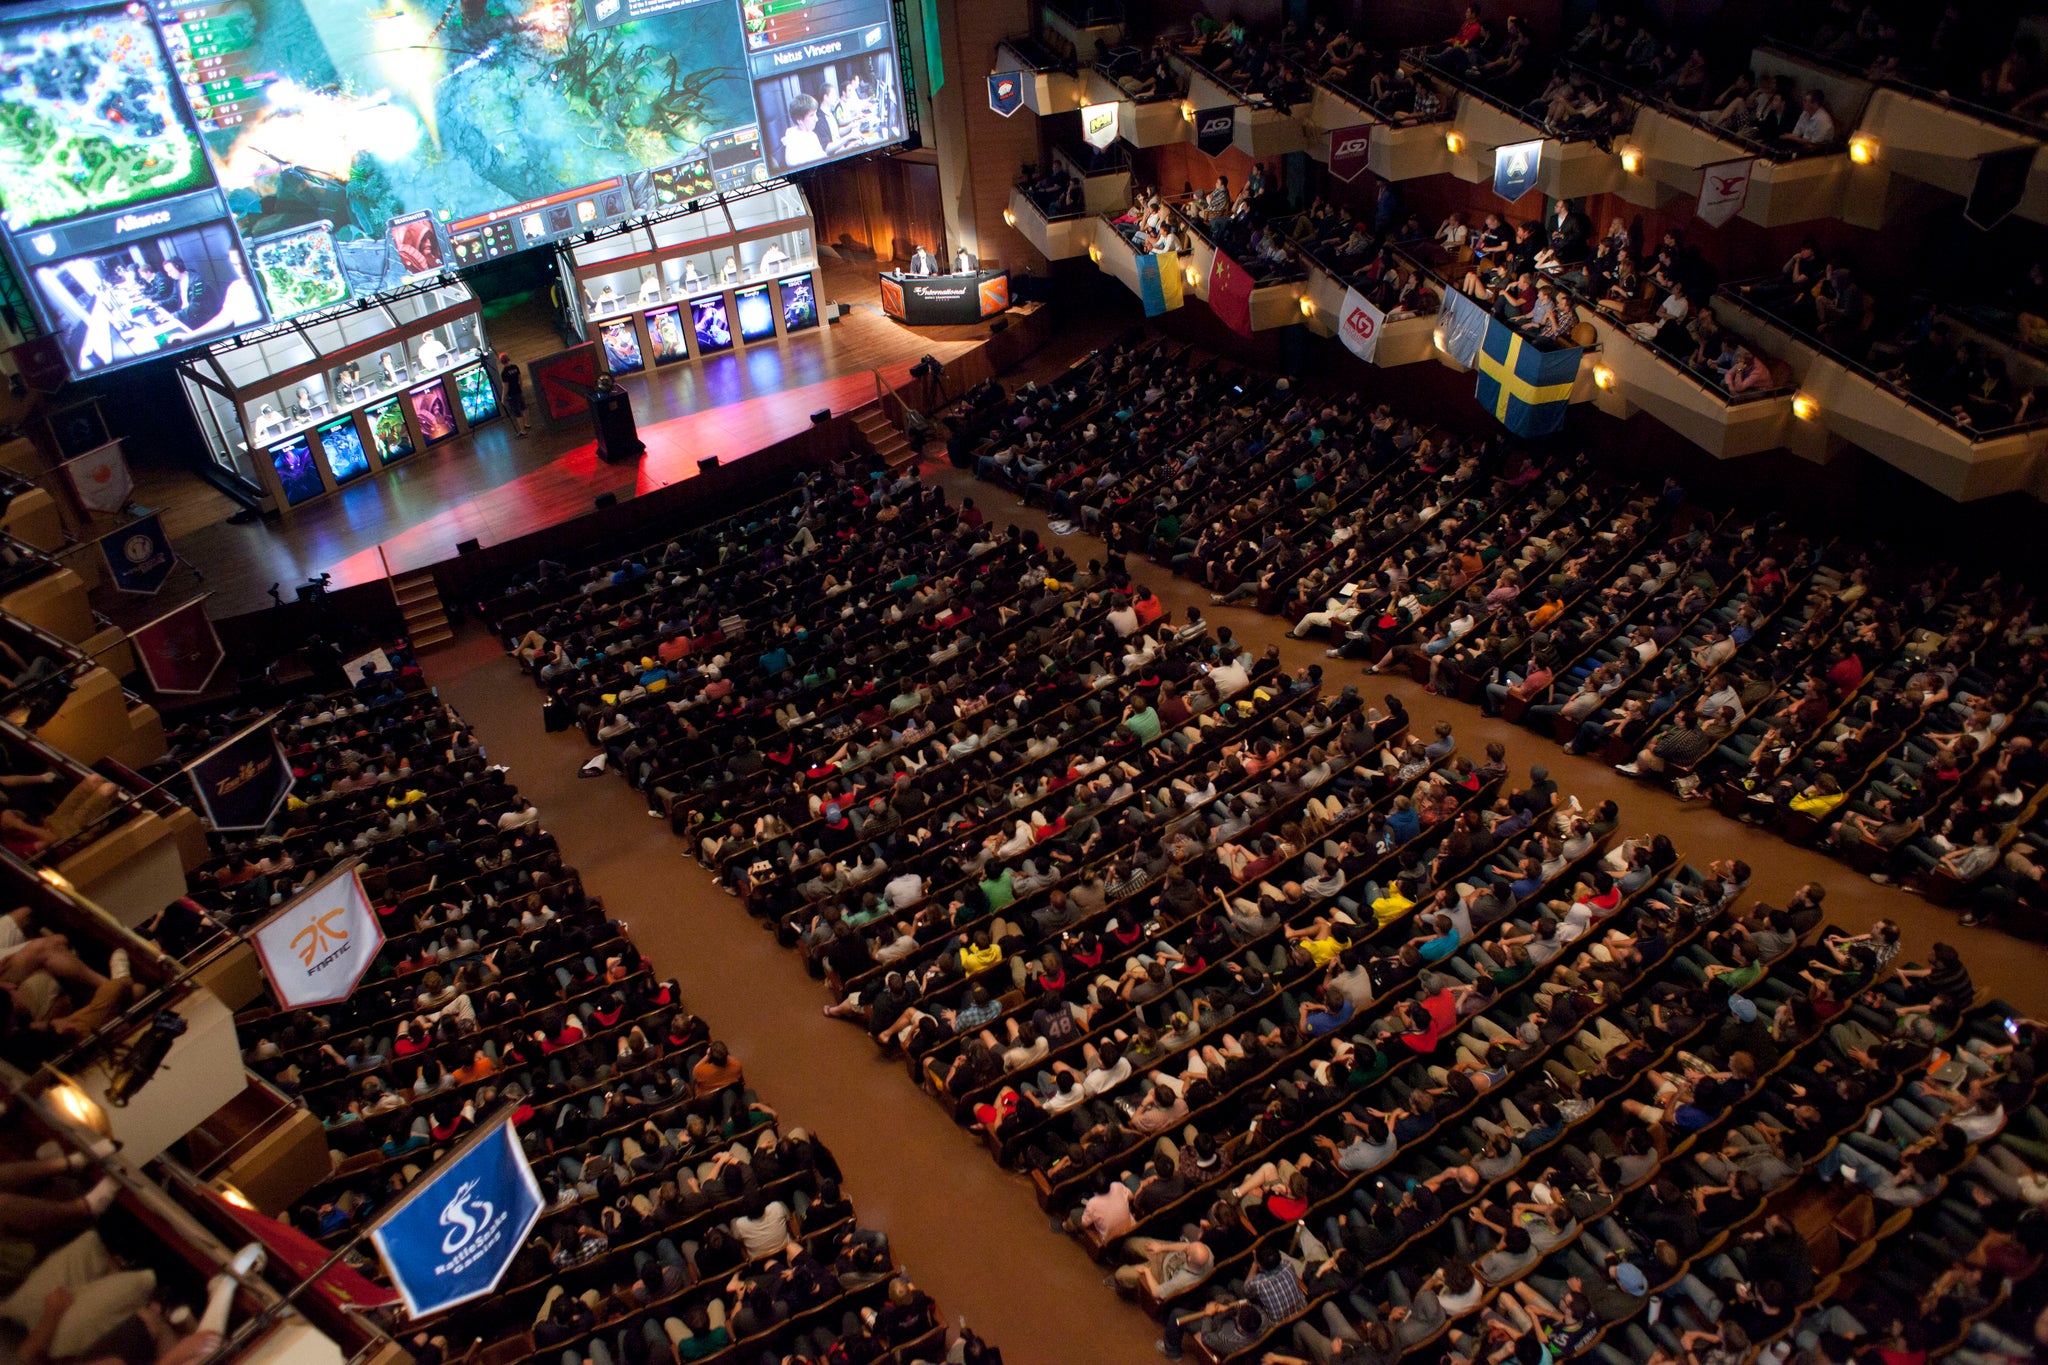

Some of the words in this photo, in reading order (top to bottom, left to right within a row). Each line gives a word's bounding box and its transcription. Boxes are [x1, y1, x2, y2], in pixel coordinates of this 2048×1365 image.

[774, 50, 803, 66] Natus
[803, 41, 842, 58] Vincere
[1334, 138, 1368, 156] LGD
[116, 210, 171, 234] Alliance
[917, 286, 967, 296] International
[1049, 1016, 1071, 1038] 48
[434, 1211, 508, 1276] RattleSnake
[453, 1230, 502, 1274] Gaming
